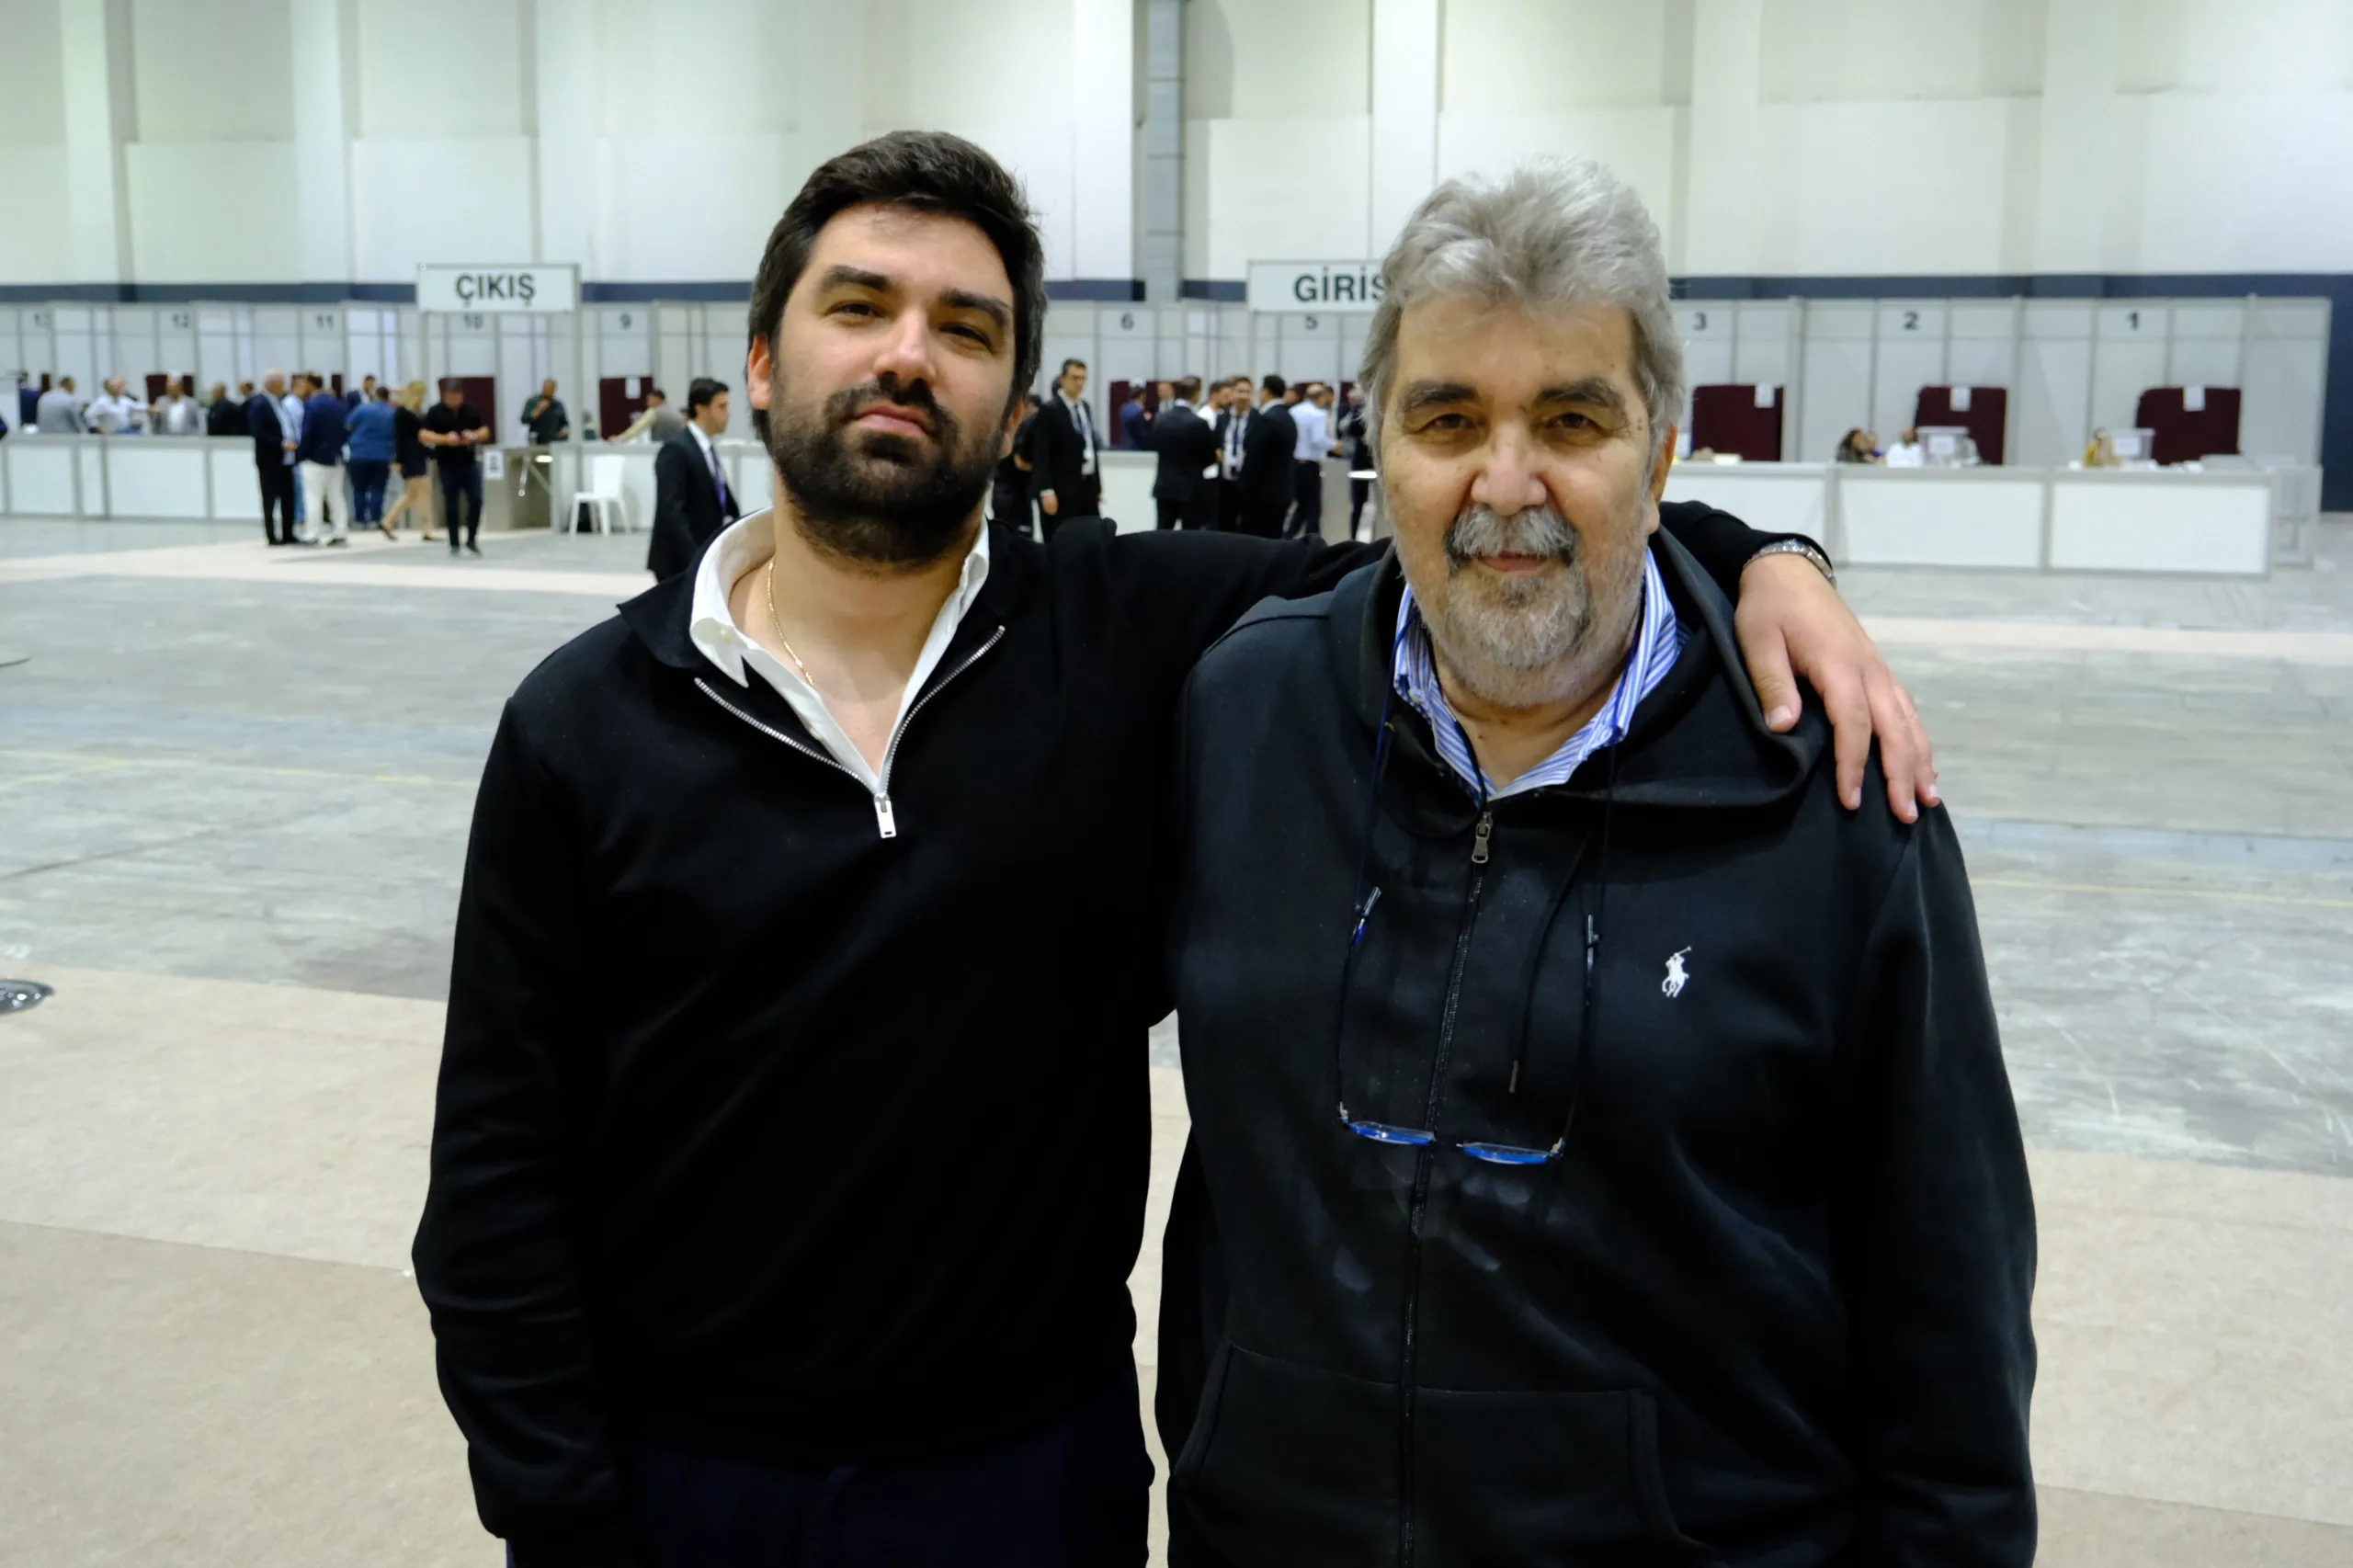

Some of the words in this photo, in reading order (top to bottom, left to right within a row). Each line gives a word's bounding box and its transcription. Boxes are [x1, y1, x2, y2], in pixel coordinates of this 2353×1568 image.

[454, 274, 536, 307] ÇIKIŞ
[172, 312, 191, 329] 12
[316, 313, 334, 330] 11
[619, 312, 632, 330] 9
[1120, 313, 1134, 331] 6
[1305, 313, 1318, 331] 5
[1692, 312, 1708, 331] 3
[1902, 312, 1919, 331] 2
[2127, 312, 2139, 331] 1
